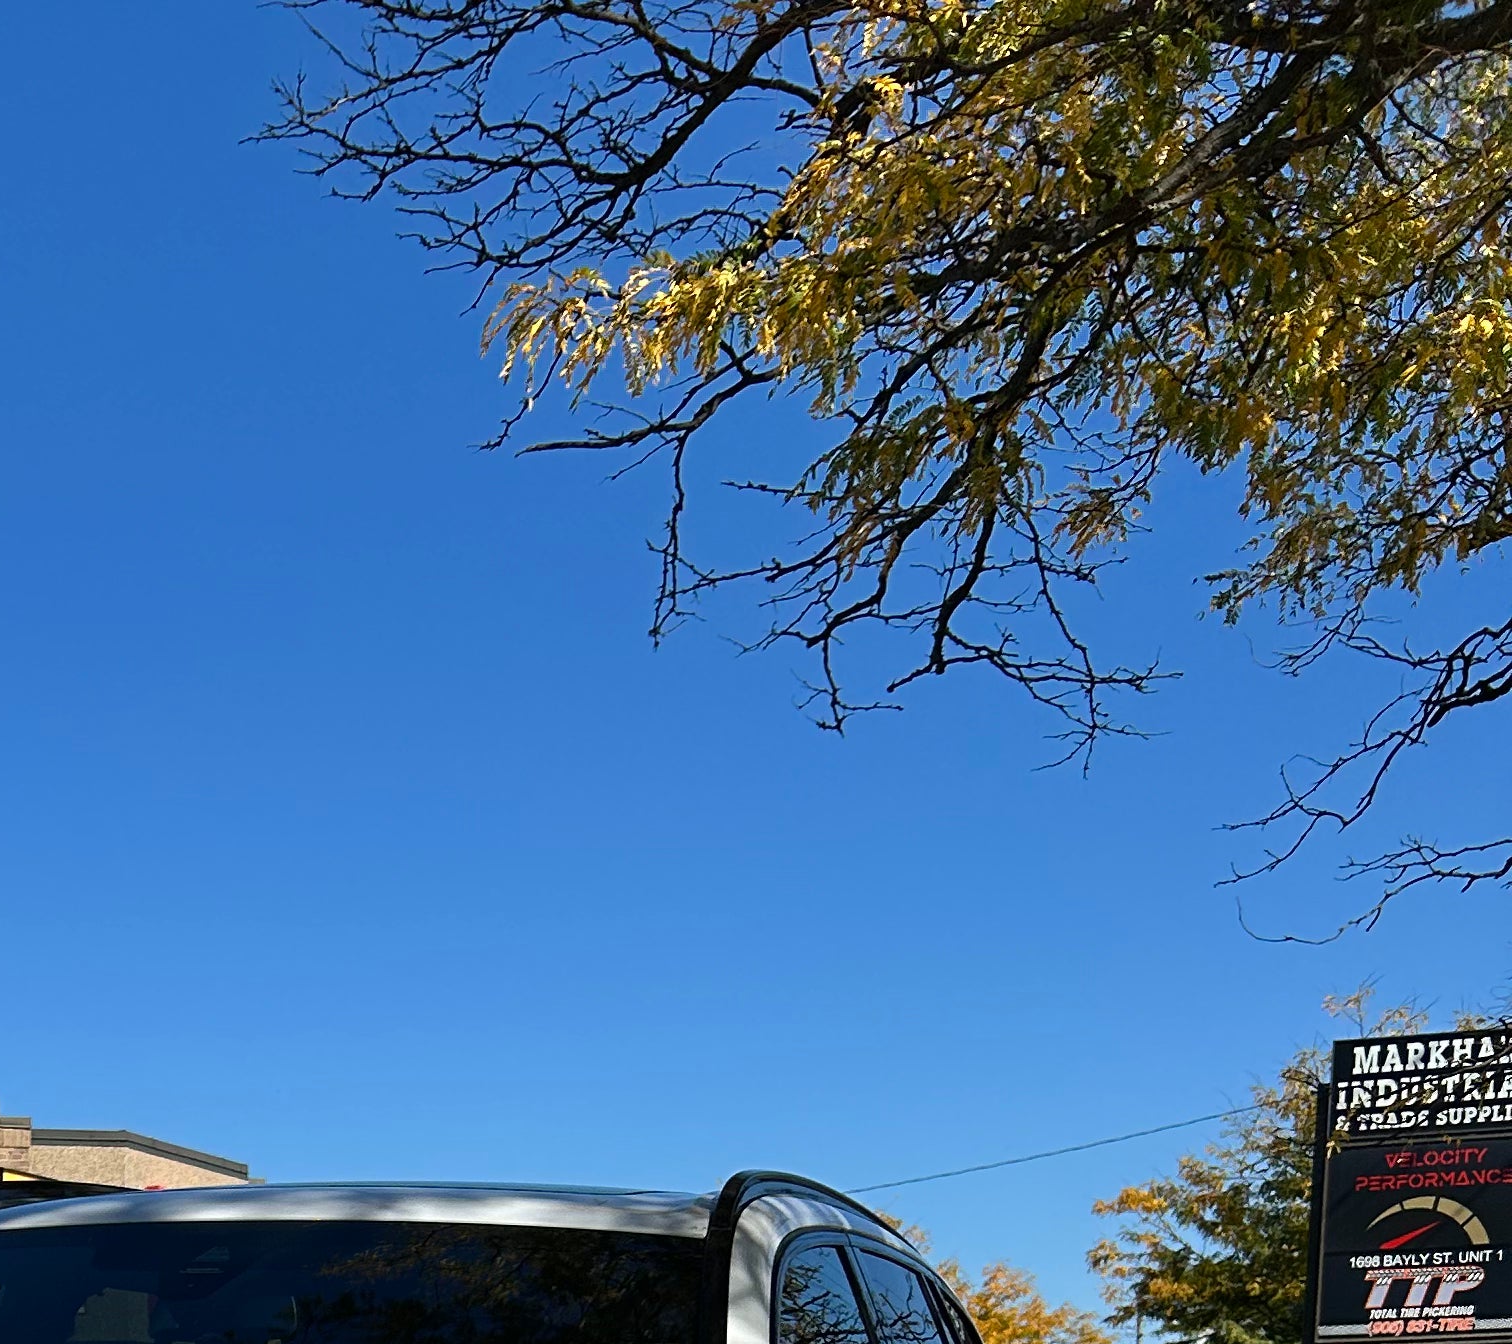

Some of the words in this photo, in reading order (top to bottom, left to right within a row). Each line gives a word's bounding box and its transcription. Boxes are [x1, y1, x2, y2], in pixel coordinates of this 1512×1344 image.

[1385, 1147, 1488, 1168] VELOCITY
[1383, 1253, 1430, 1267] BAYLY
[1458, 1250, 1493, 1263] UNIT
[1496, 1249, 1504, 1261] 1
[1364, 1265, 1485, 1309] TTP
[1370, 1308, 1397, 1320] TOTAL
[1399, 1307, 1421, 1318] TIRE
[1422, 1305, 1475, 1317] PICKERING
